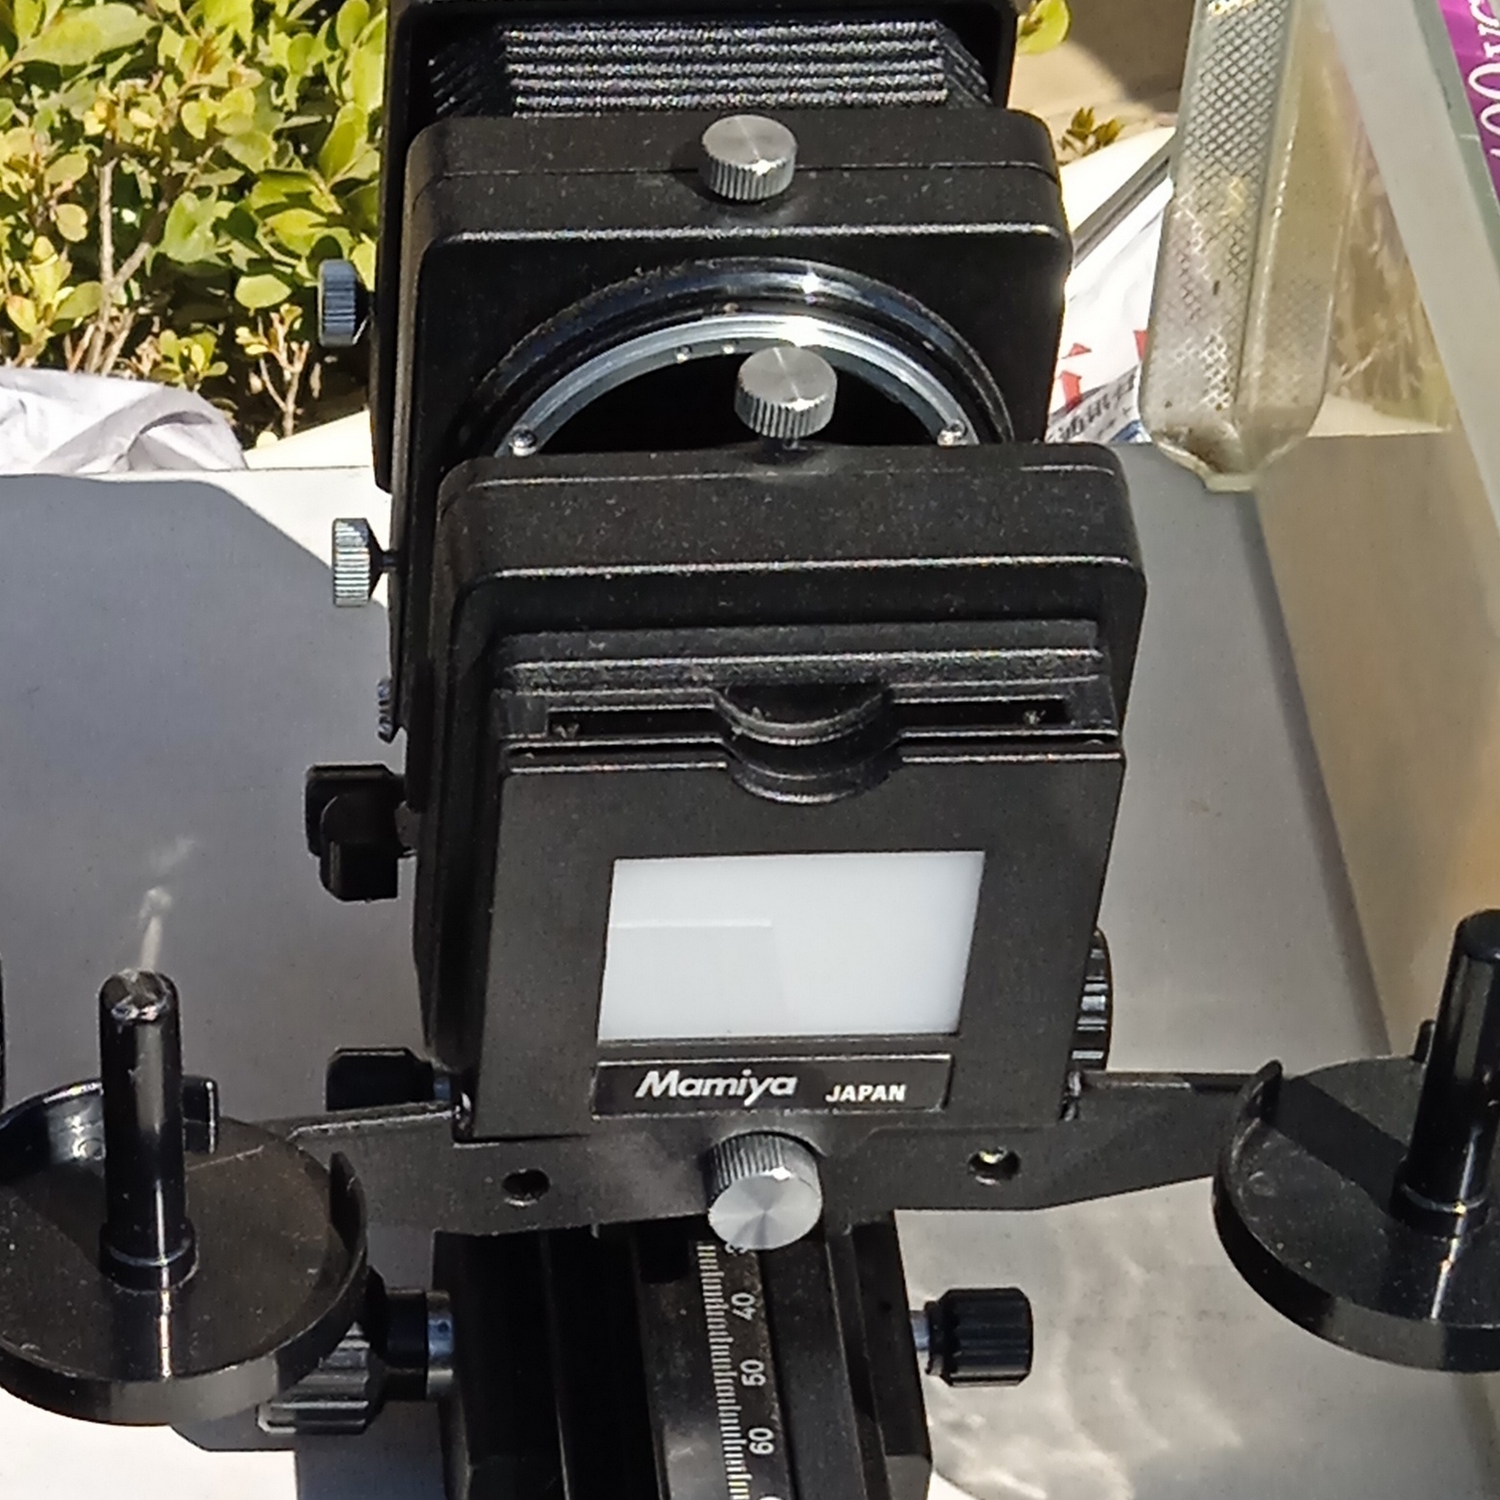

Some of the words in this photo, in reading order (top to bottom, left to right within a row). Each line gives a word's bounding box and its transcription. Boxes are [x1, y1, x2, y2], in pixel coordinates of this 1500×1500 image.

[635, 1069, 797, 1106] Mamiya
[825, 1084, 906, 1103] JAPAN
[731, 1292, 756, 1320] 40
[741, 1359, 766, 1387] 50
[749, 1427, 775, 1455] 60
